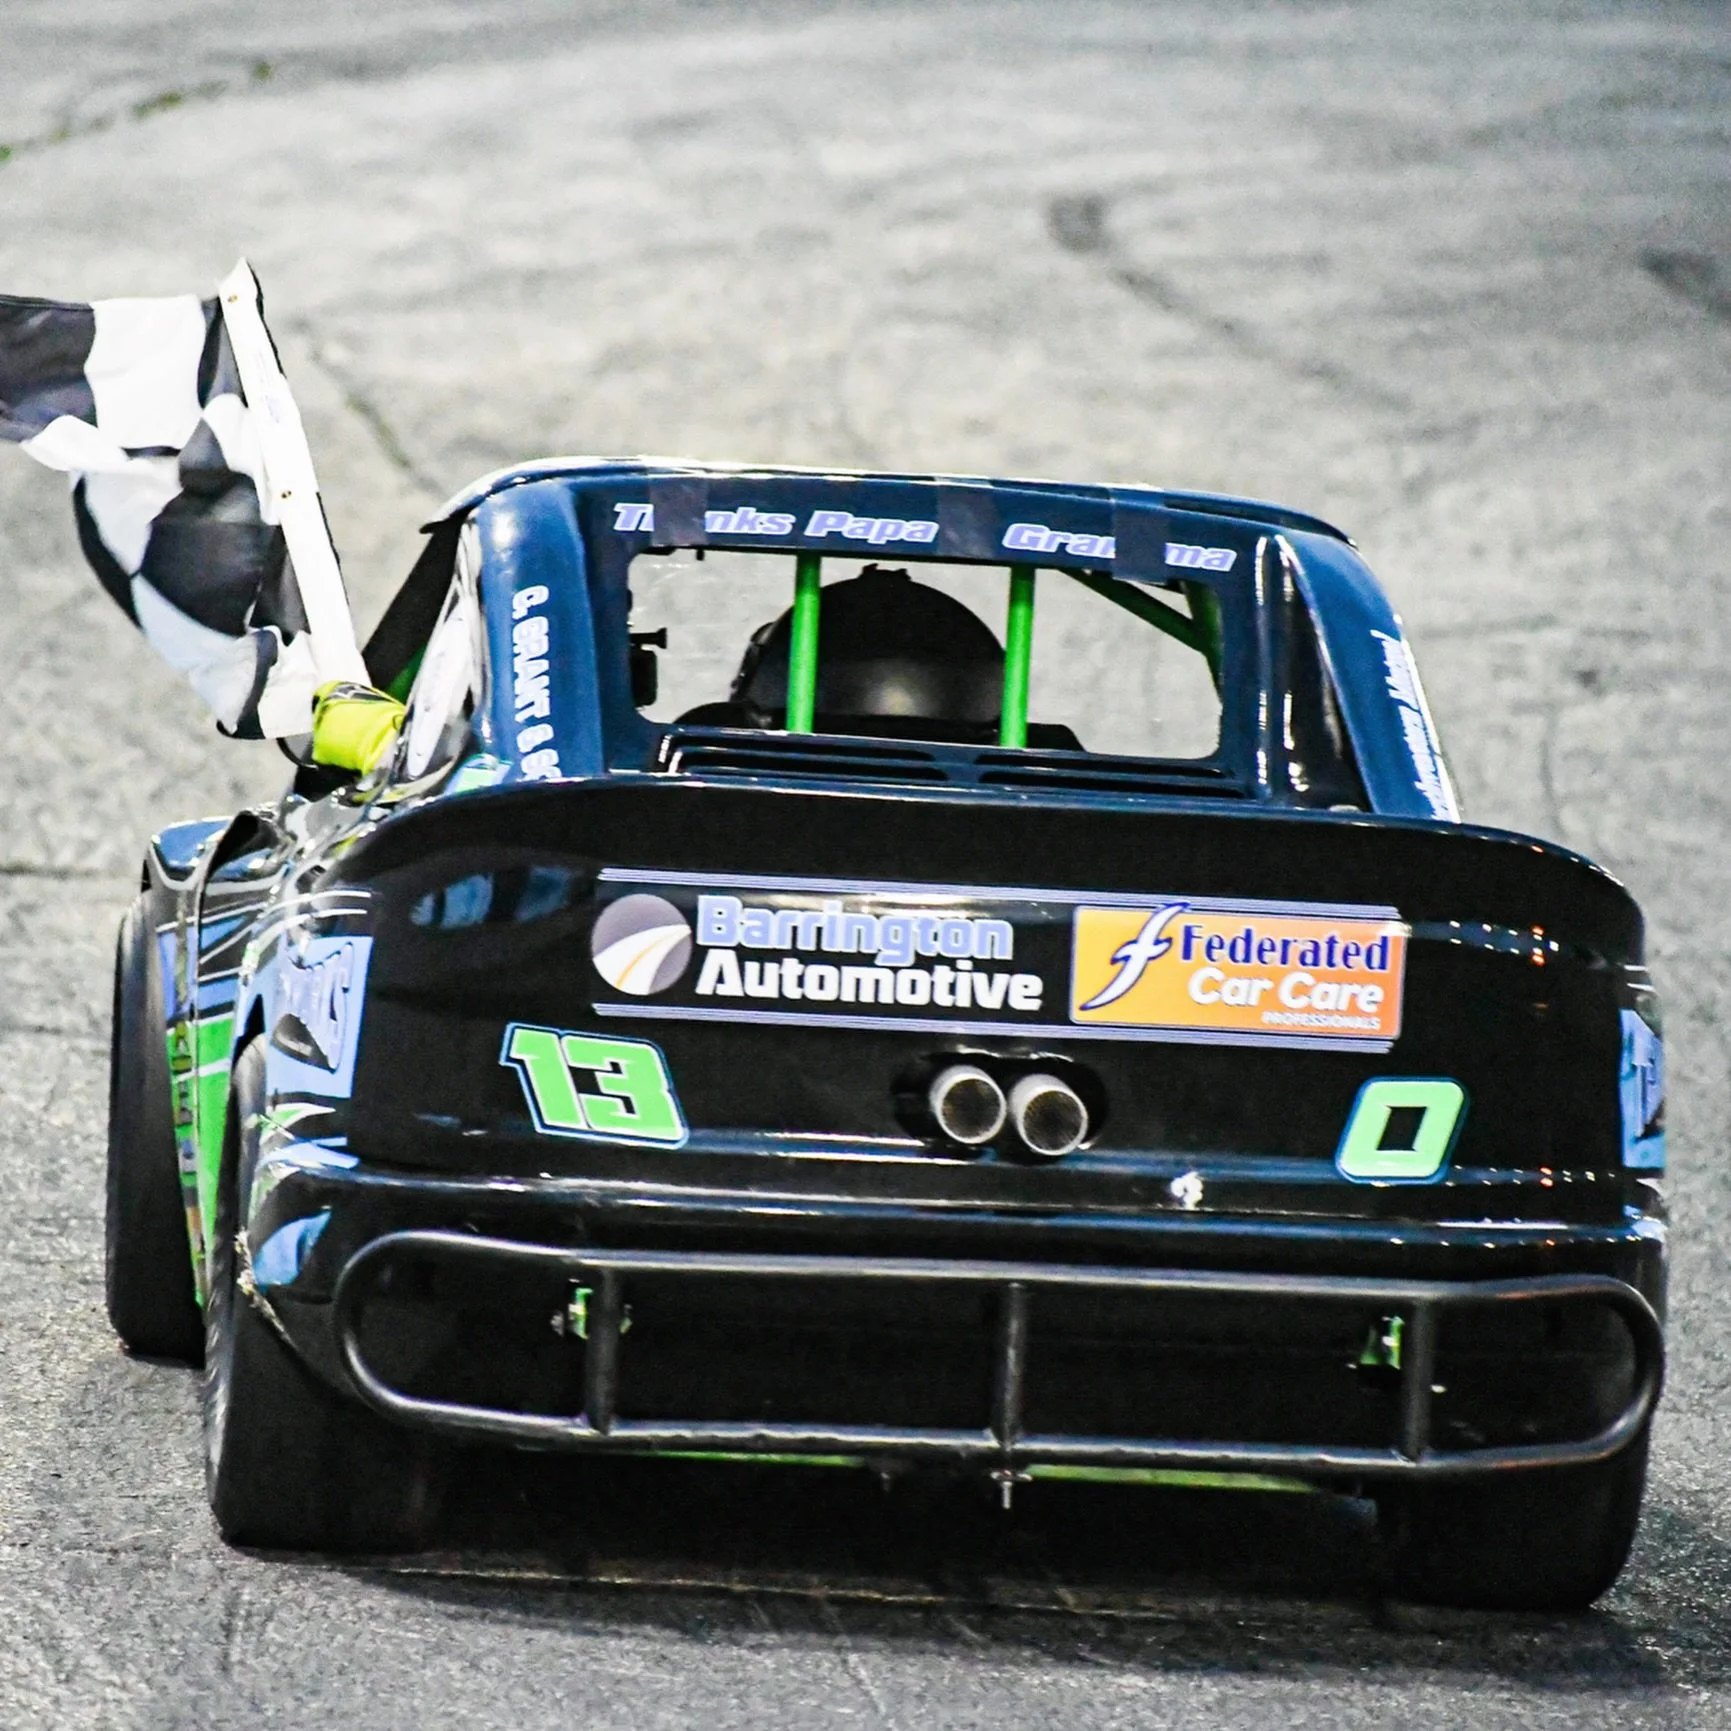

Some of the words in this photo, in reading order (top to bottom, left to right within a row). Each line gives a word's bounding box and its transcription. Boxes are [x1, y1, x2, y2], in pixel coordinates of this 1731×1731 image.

[613, 503, 796, 535] Tnks
[803, 510, 939, 543] Papa
[512, 616, 550, 723] GRANT
[697, 895, 1013, 966] Barrington
[1181, 924, 1391, 973] Federated
[696, 948, 1043, 1010] Automotive
[1188, 967, 1274, 1006] Car
[1278, 971, 1385, 1013] Care
[499, 1022, 689, 1150] 13
